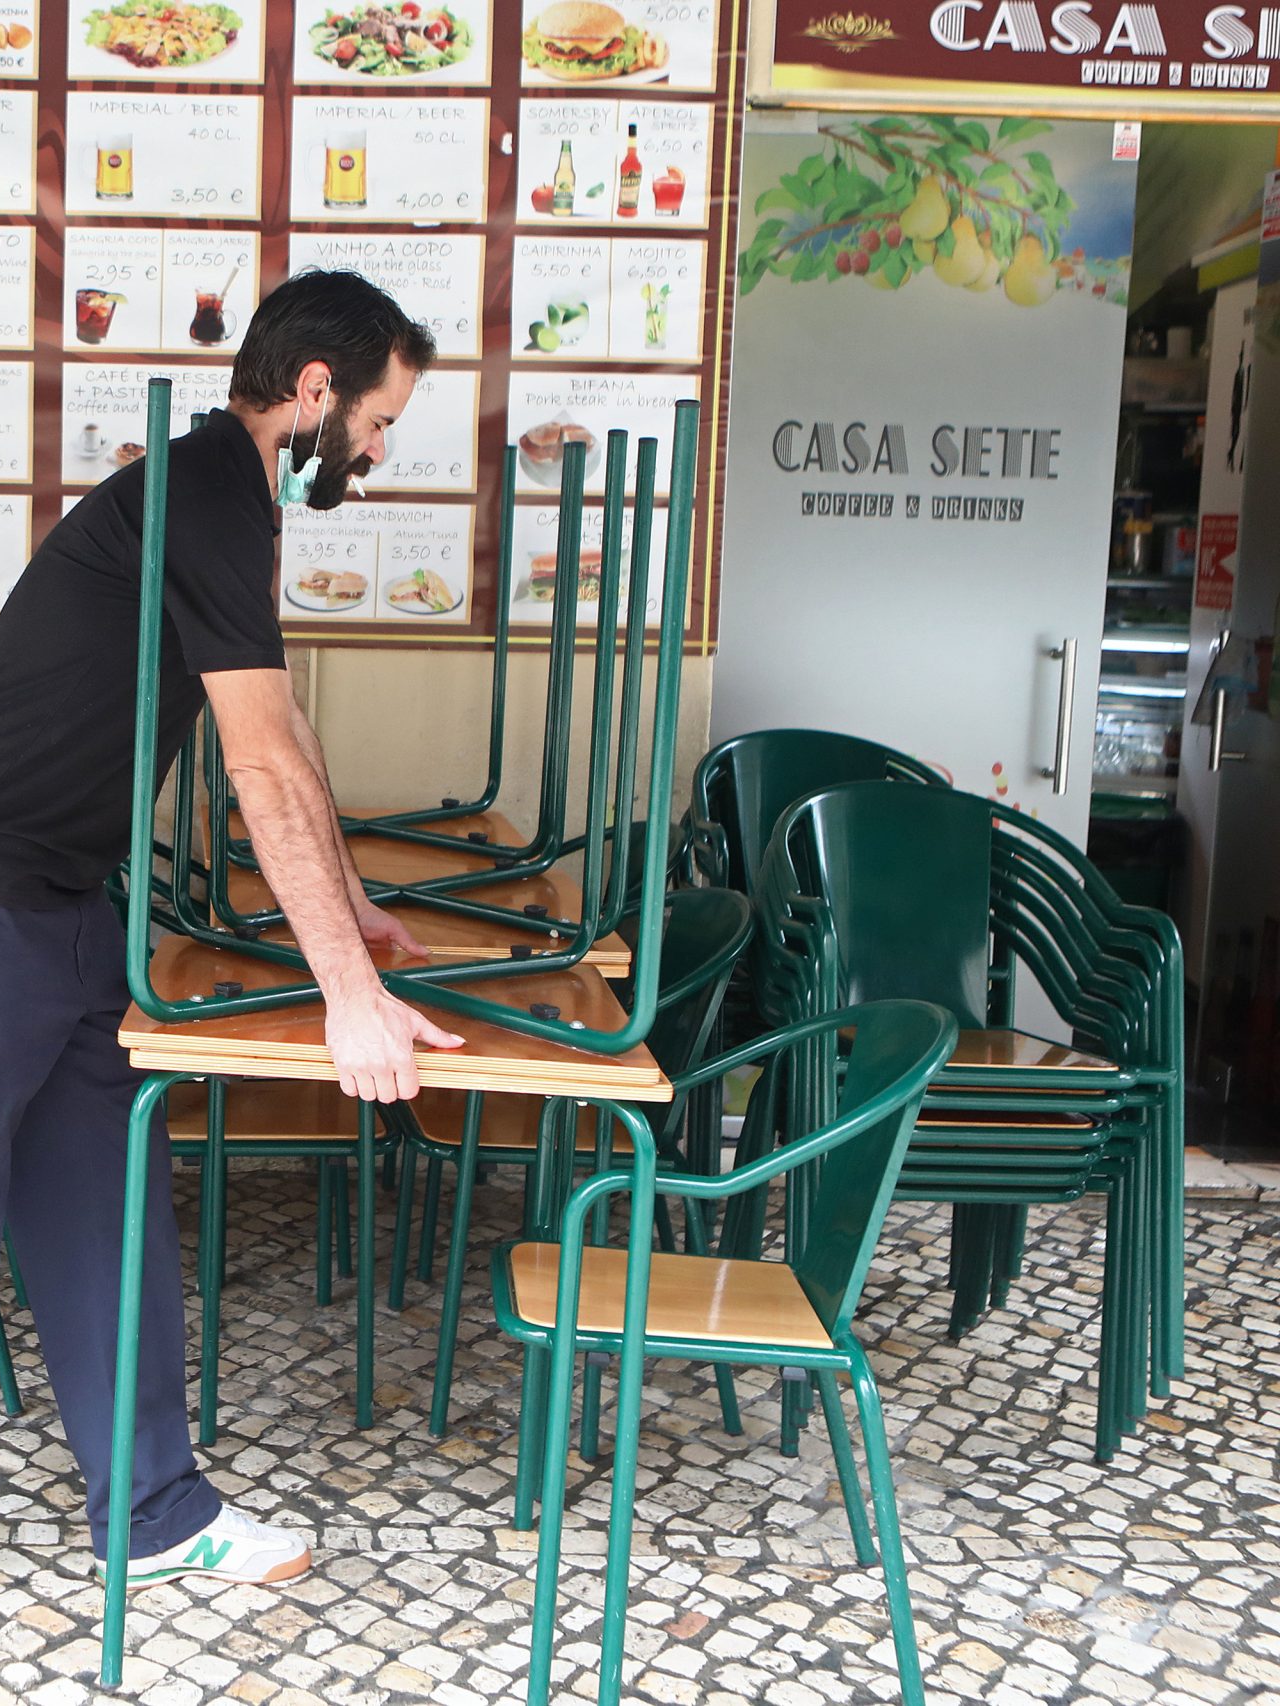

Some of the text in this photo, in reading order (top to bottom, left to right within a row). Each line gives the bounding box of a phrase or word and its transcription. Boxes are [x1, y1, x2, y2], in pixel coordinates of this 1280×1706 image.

[645, 6, 691, 23] 5,00
[930, 0, 1167, 56] CASA
[17, 57, 24, 67] €
[1081, 59, 1161, 85] COFFEE
[1191, 63, 1269, 88] DRINKS
[90, 101, 239, 117] IMPERIAL BEER
[315, 106, 466, 120] IMPERIAL BEER
[528, 108, 610, 124] SOMERSBY
[630, 107, 696, 120] APEROL
[188, 128, 209, 140] 40
[590, 123, 600, 135] €
[413, 132, 433, 143] 50
[693, 140, 703, 153] €
[10, 183, 22, 198] €
[171, 189, 243, 204] 3,50 €
[397, 192, 469, 209] 4,00 €
[70, 234, 124, 245] SANGRIA
[169, 234, 215, 246] SANGRIA
[317, 242, 452, 257] VINHO A COPO
[521, 244, 601, 258] CAIPIRINHA
[628, 247, 687, 263] MOJITO
[0, 257, 27, 268] Wine
[172, 252, 249, 268] 10,50 €
[364, 258, 380, 275] by
[384, 259, 403, 270] the
[408, 259, 442, 275] glass
[86, 264, 158, 287] 2,95 €
[531, 264, 591, 278] 5,50 €
[627, 265, 688, 280] 6,50 €
[18, 325, 27, 336] €
[456, 317, 469, 333] €
[85, 370, 129, 382] CAFÉ
[93, 386, 148, 399] PASTE
[195, 388, 230, 400] NAT
[570, 379, 635, 392] BIFANA
[67, 400, 108, 416] Coffee
[113, 402, 140, 413] and
[526, 393, 677, 408] Pork steak in bread
[772, 420, 1062, 480] CASA SETE
[10, 459, 18, 469] €
[392, 462, 462, 478] 1,50 €
[801, 492, 1024, 521] COFFEE & DRINKS
[356, 509, 433, 523] SANDWICH
[297, 542, 357, 563] 3,95 €
[392, 545, 452, 560] 3,50 €
